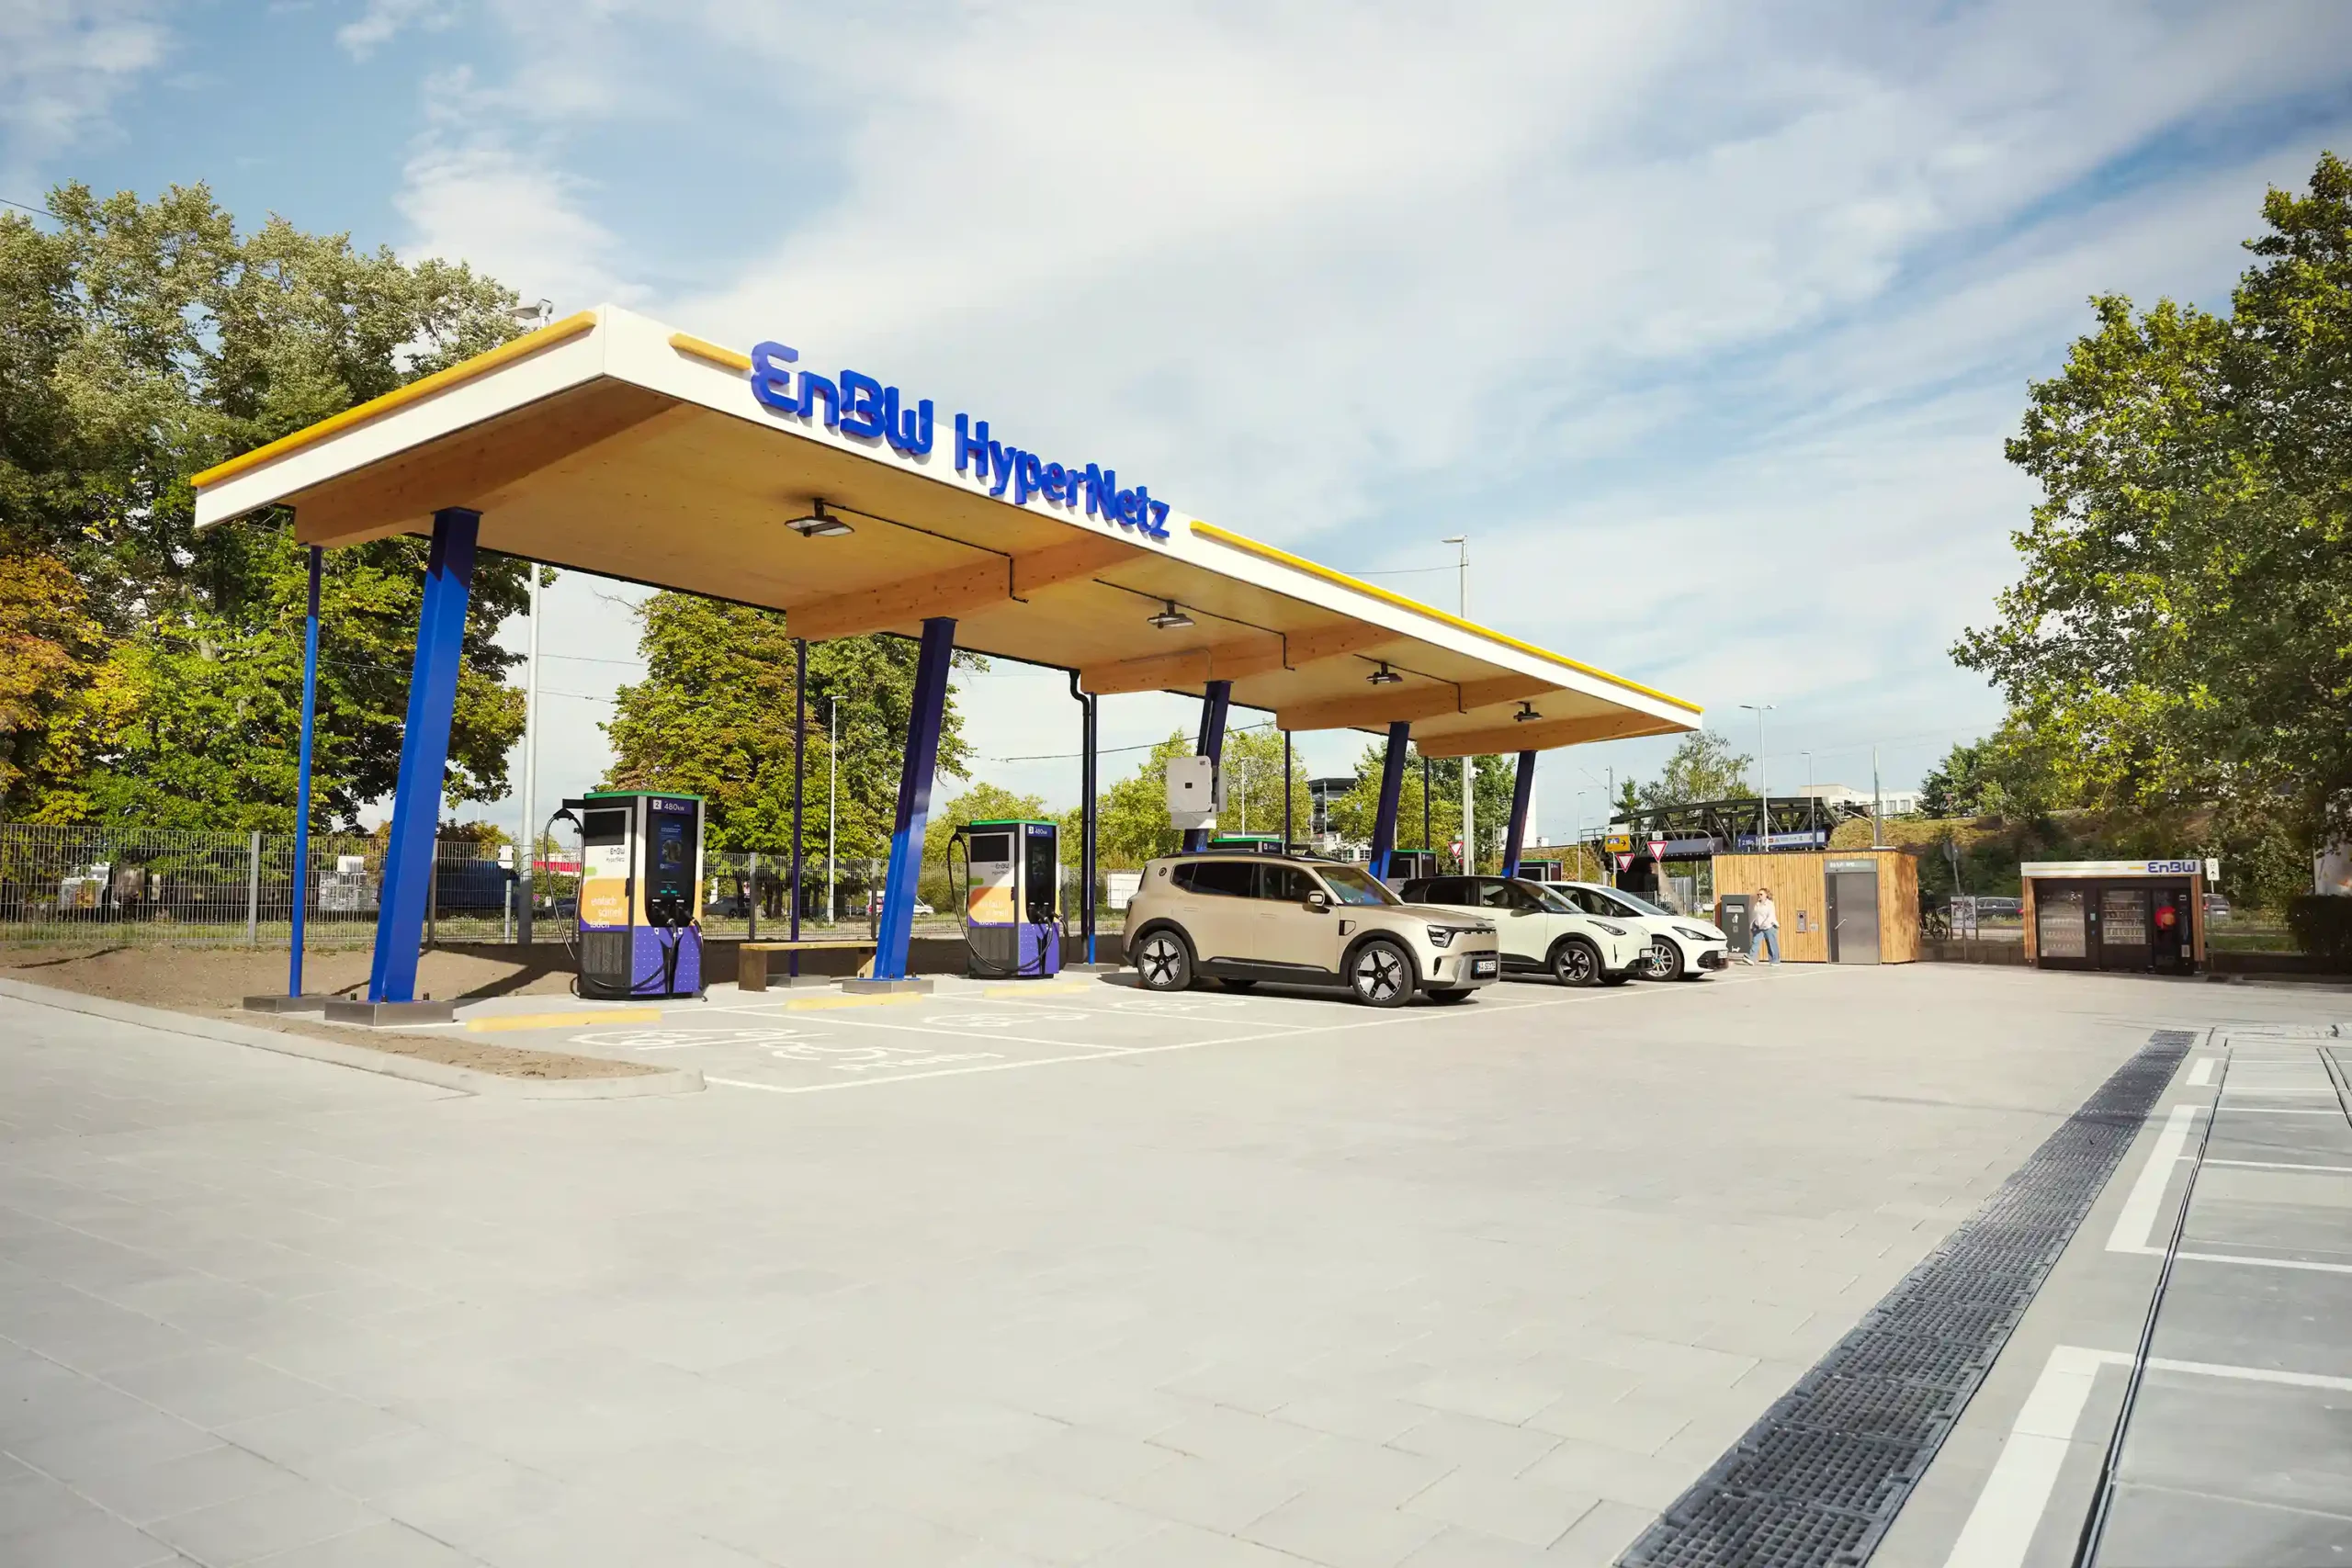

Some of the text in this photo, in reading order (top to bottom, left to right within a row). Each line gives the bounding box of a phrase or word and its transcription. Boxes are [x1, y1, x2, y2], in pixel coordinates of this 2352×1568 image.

[751, 340, 1170, 538] EnBW HyperNetz
[2148, 862, 2196, 873] EnBW
[590, 918, 610, 929] laden
